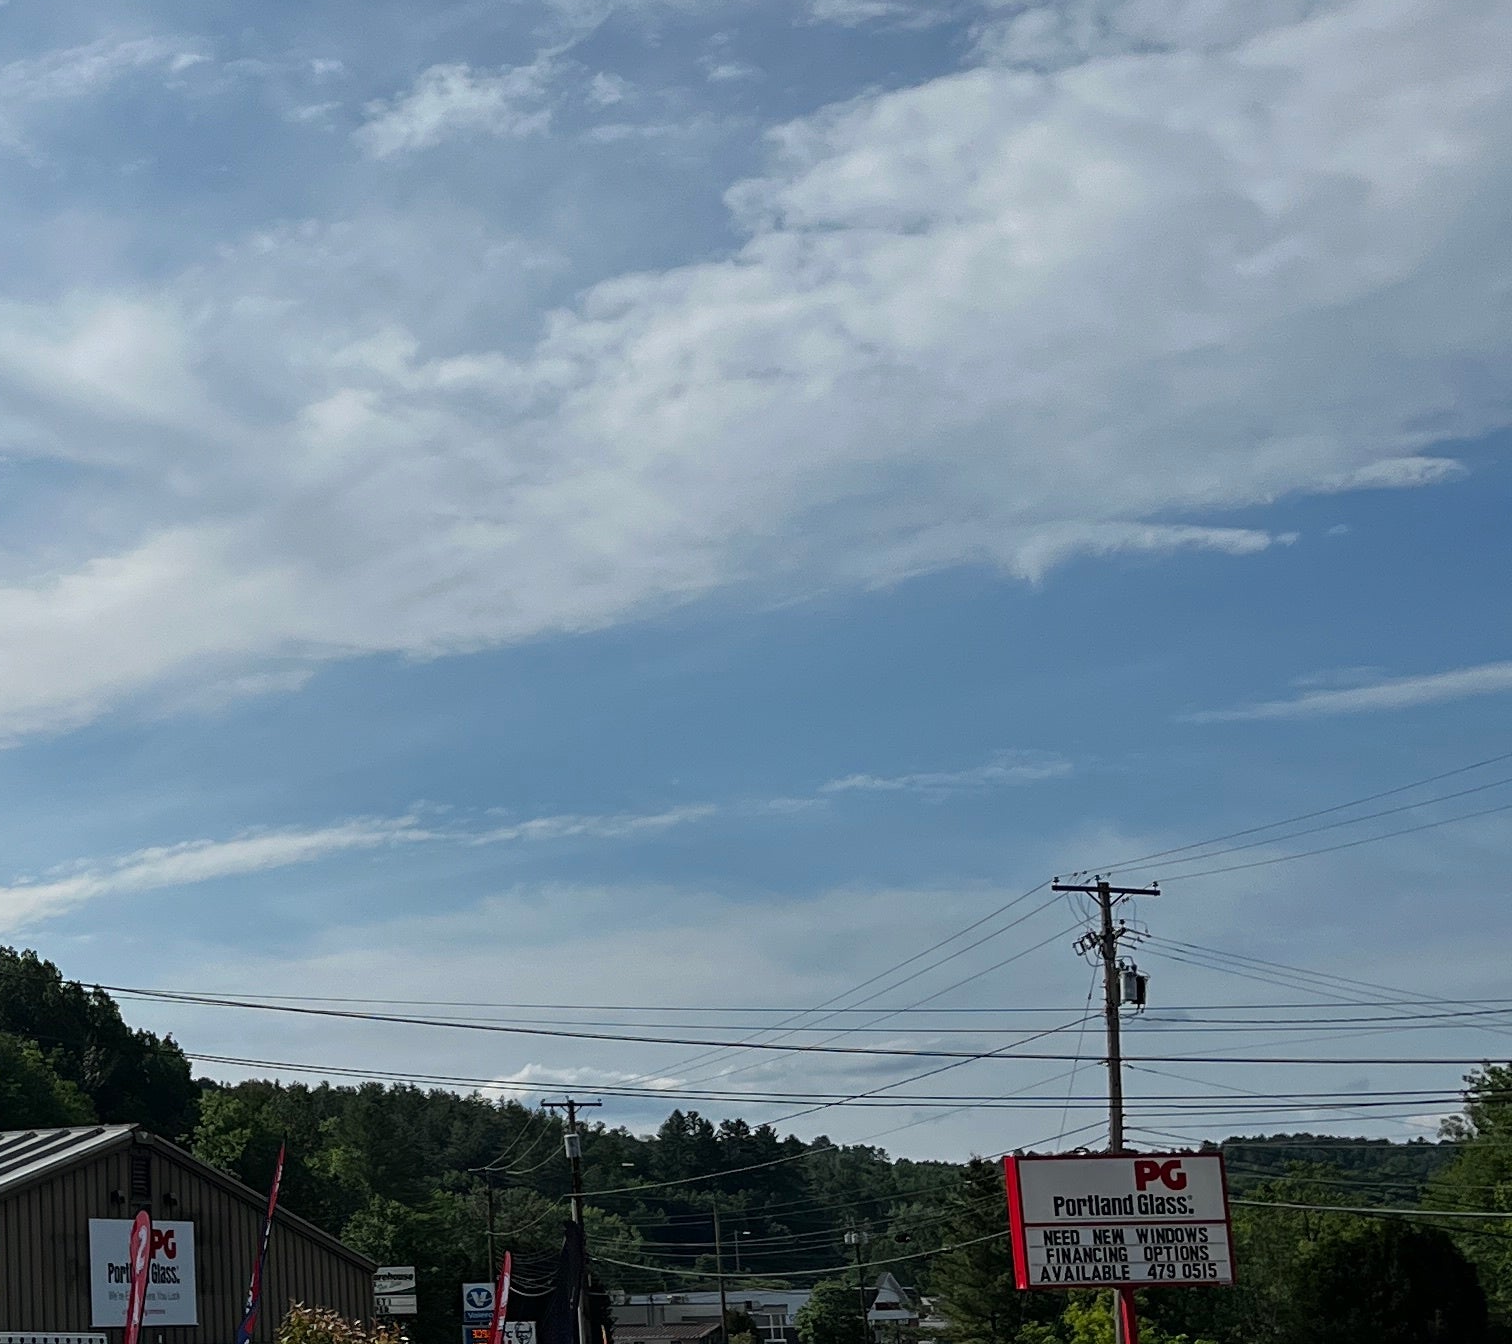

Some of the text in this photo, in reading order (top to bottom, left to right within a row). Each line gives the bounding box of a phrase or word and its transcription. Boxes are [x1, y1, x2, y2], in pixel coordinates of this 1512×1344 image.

[1134, 1160, 1187, 1191] PG
[1053, 1194, 1134, 1217] Portland
[150, 1229, 176, 1259] PG
[1043, 1227, 1209, 1246] NEED NEW WINDOWS
[1046, 1245, 1209, 1264] FINANCING OPTIONS
[1040, 1262, 1217, 1282] AVAILABLE 479 0515
